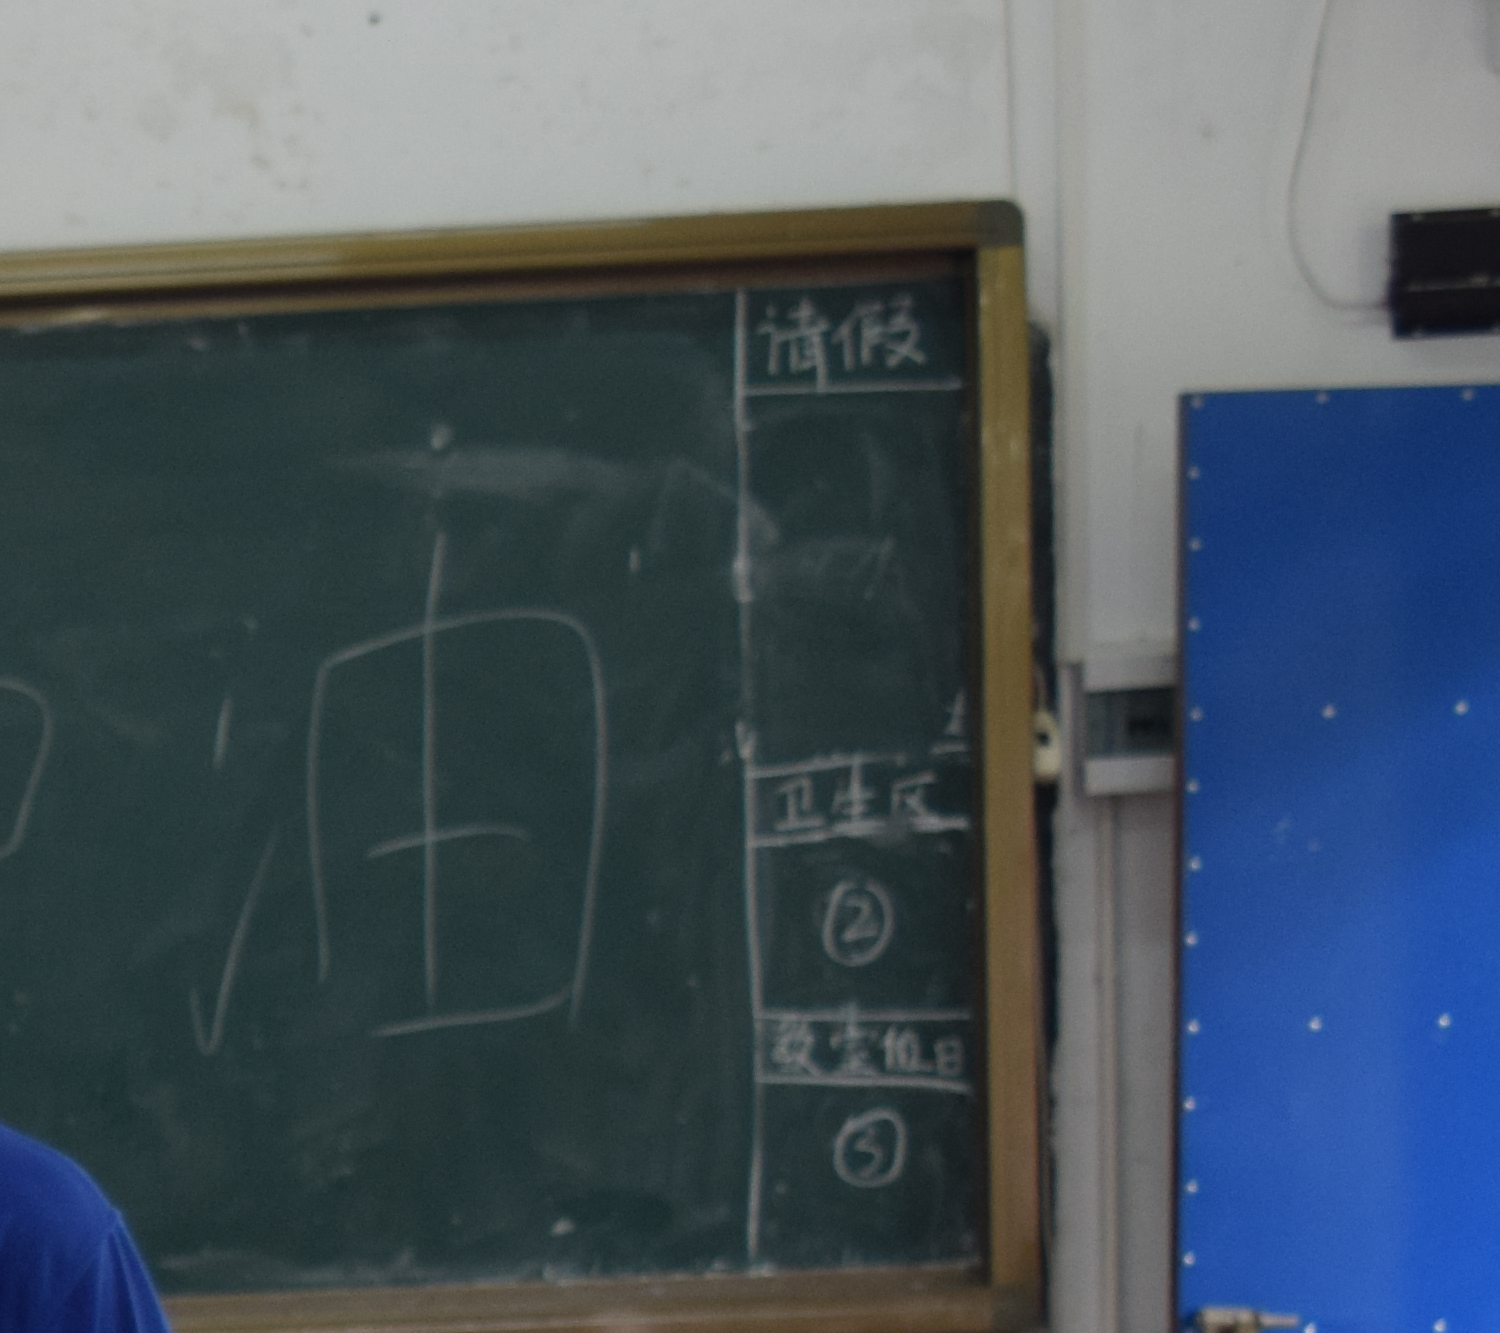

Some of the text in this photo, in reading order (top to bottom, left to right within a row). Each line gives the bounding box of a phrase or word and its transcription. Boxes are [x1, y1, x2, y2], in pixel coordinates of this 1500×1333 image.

[757, 300, 929, 392] 请假
[773, 756, 945, 832] 卫生区
